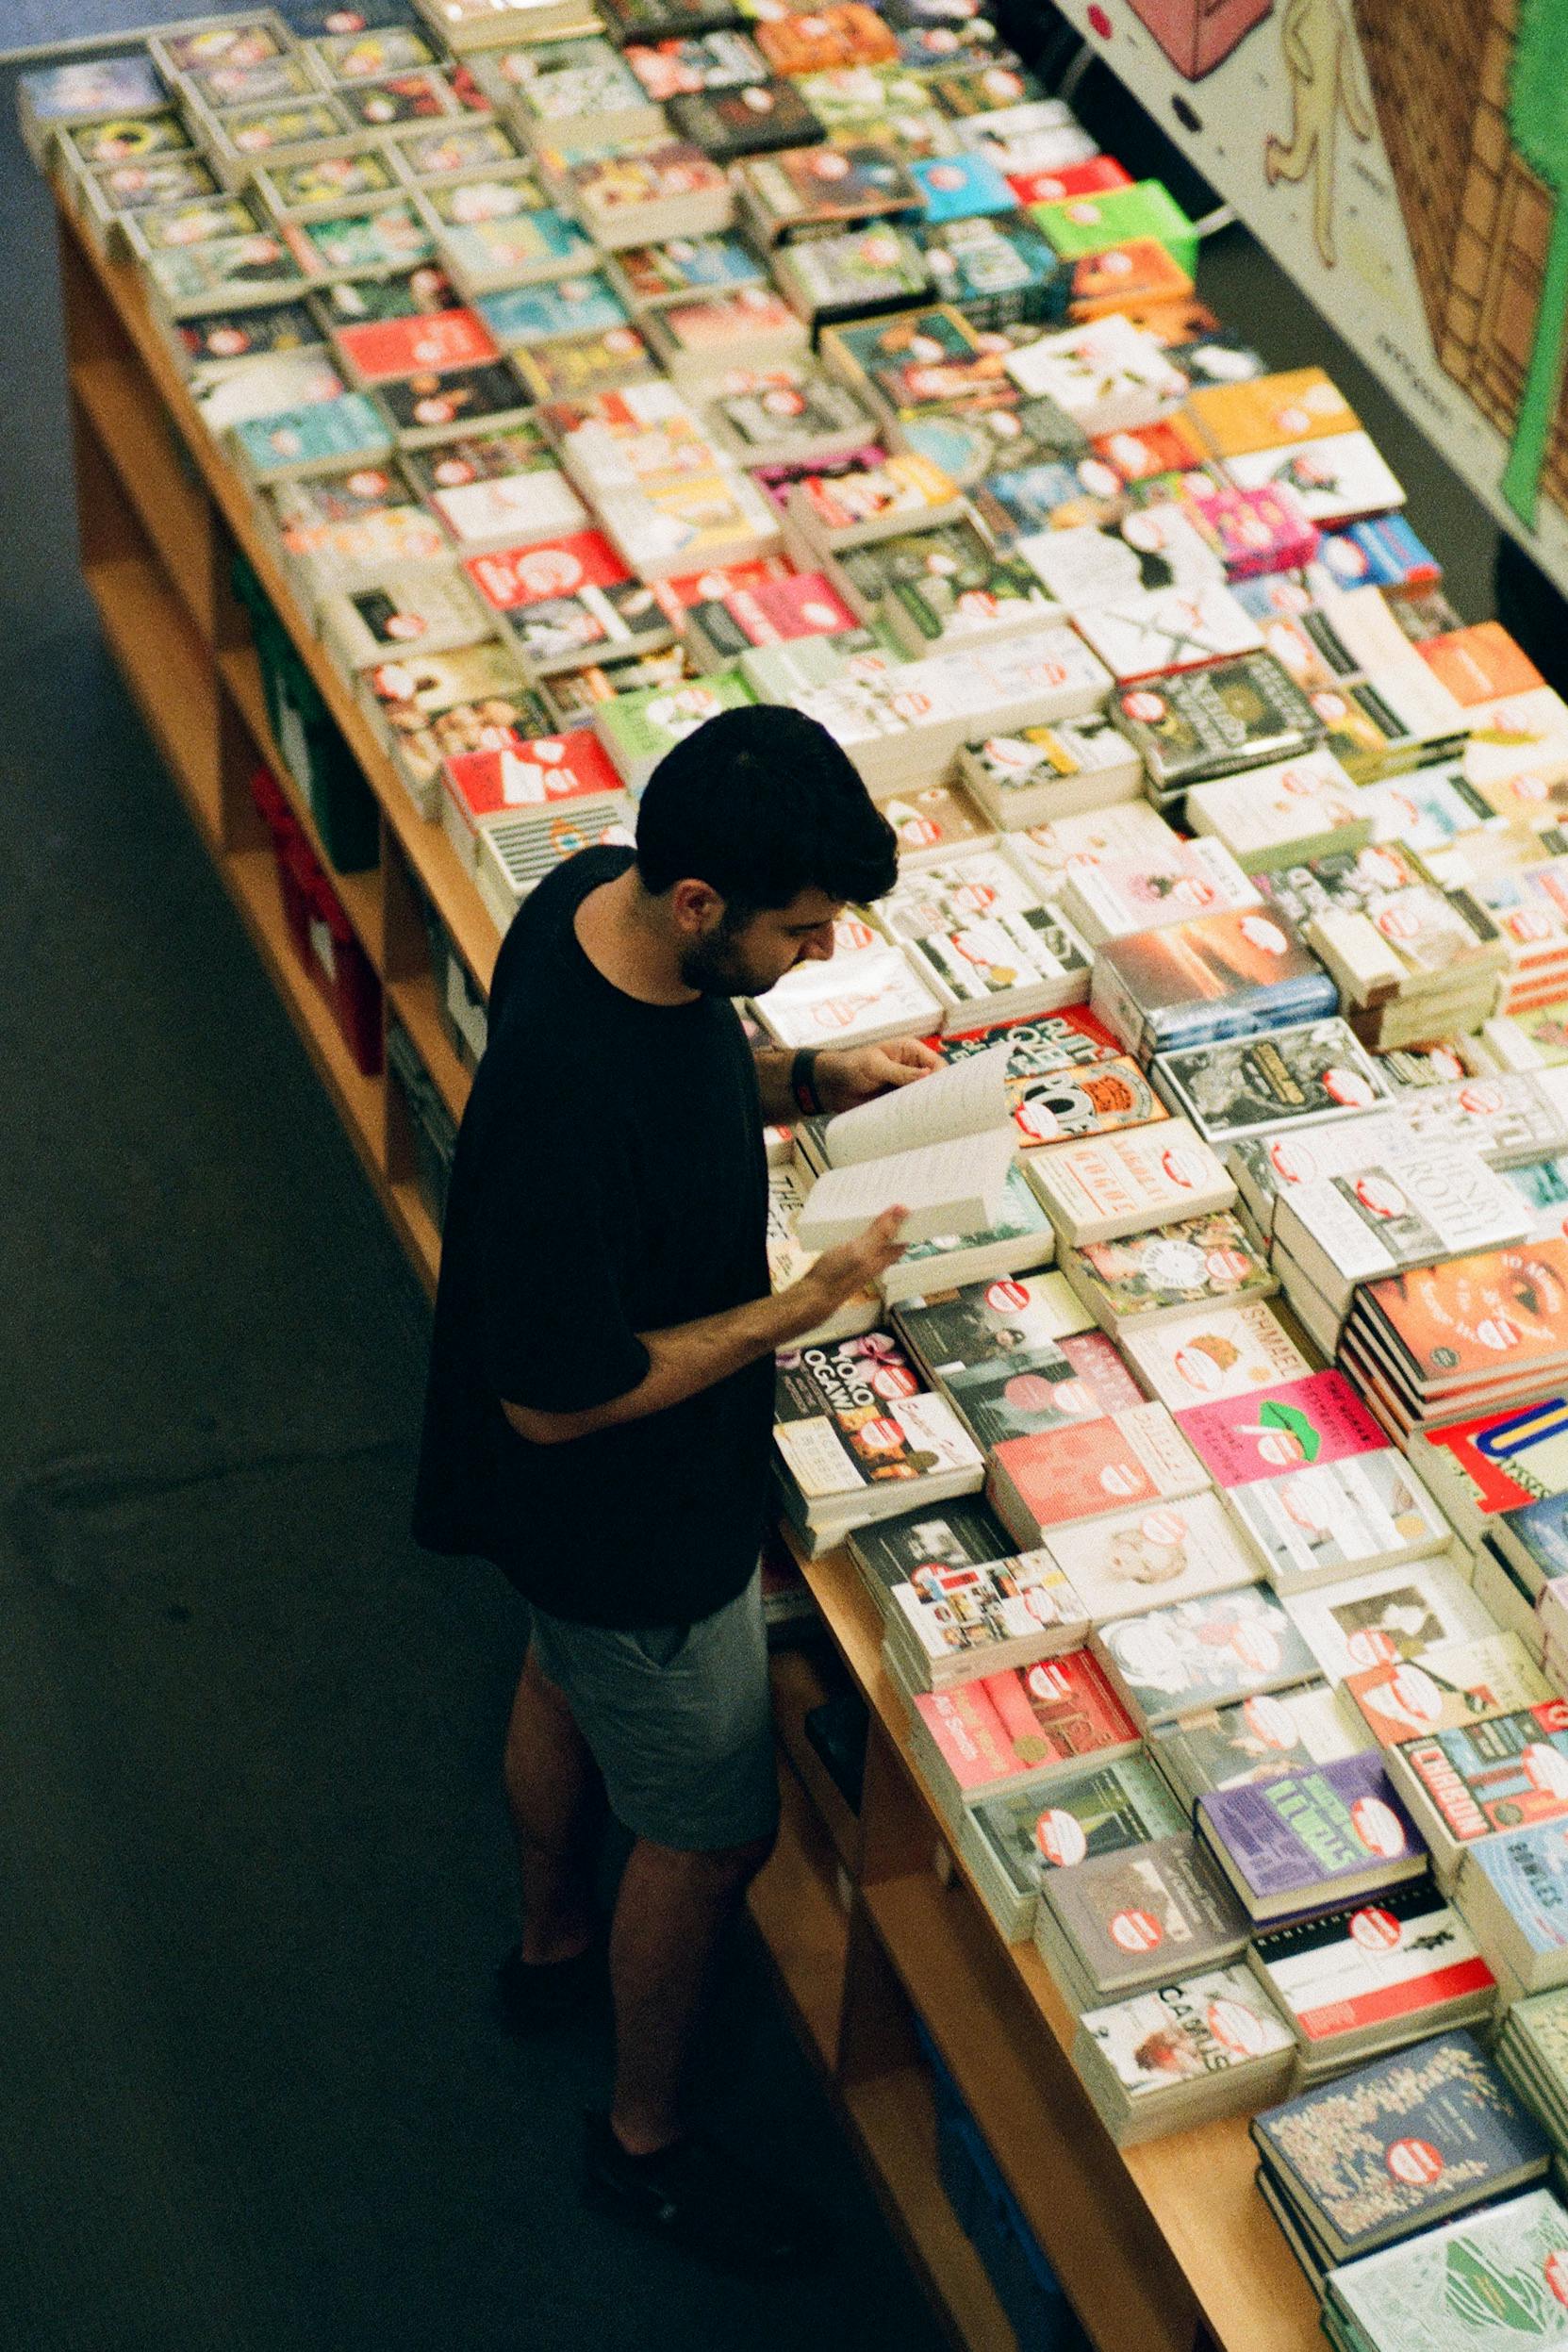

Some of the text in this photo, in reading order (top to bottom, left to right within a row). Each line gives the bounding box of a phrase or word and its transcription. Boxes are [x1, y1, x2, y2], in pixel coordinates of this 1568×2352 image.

[1021, 1070, 1106, 1136] POE
[766, 1175, 804, 1213] THE
[1071, 1148, 1138, 1216] GOGOL
[1397, 1160, 1483, 1237] ROTH
[1438, 1152, 1509, 1226] HENRY
[1235, 1300, 1305, 1377] ISHMAEL
[827, 1351, 877, 1407] YOKO
[930, 1692, 982, 1762] Ali Smith
[1404, 1744, 1492, 1840] CHABON
[1505, 1840, 1565, 1909] BOWLES
[1154, 1983, 1231, 2072] CAMUS
